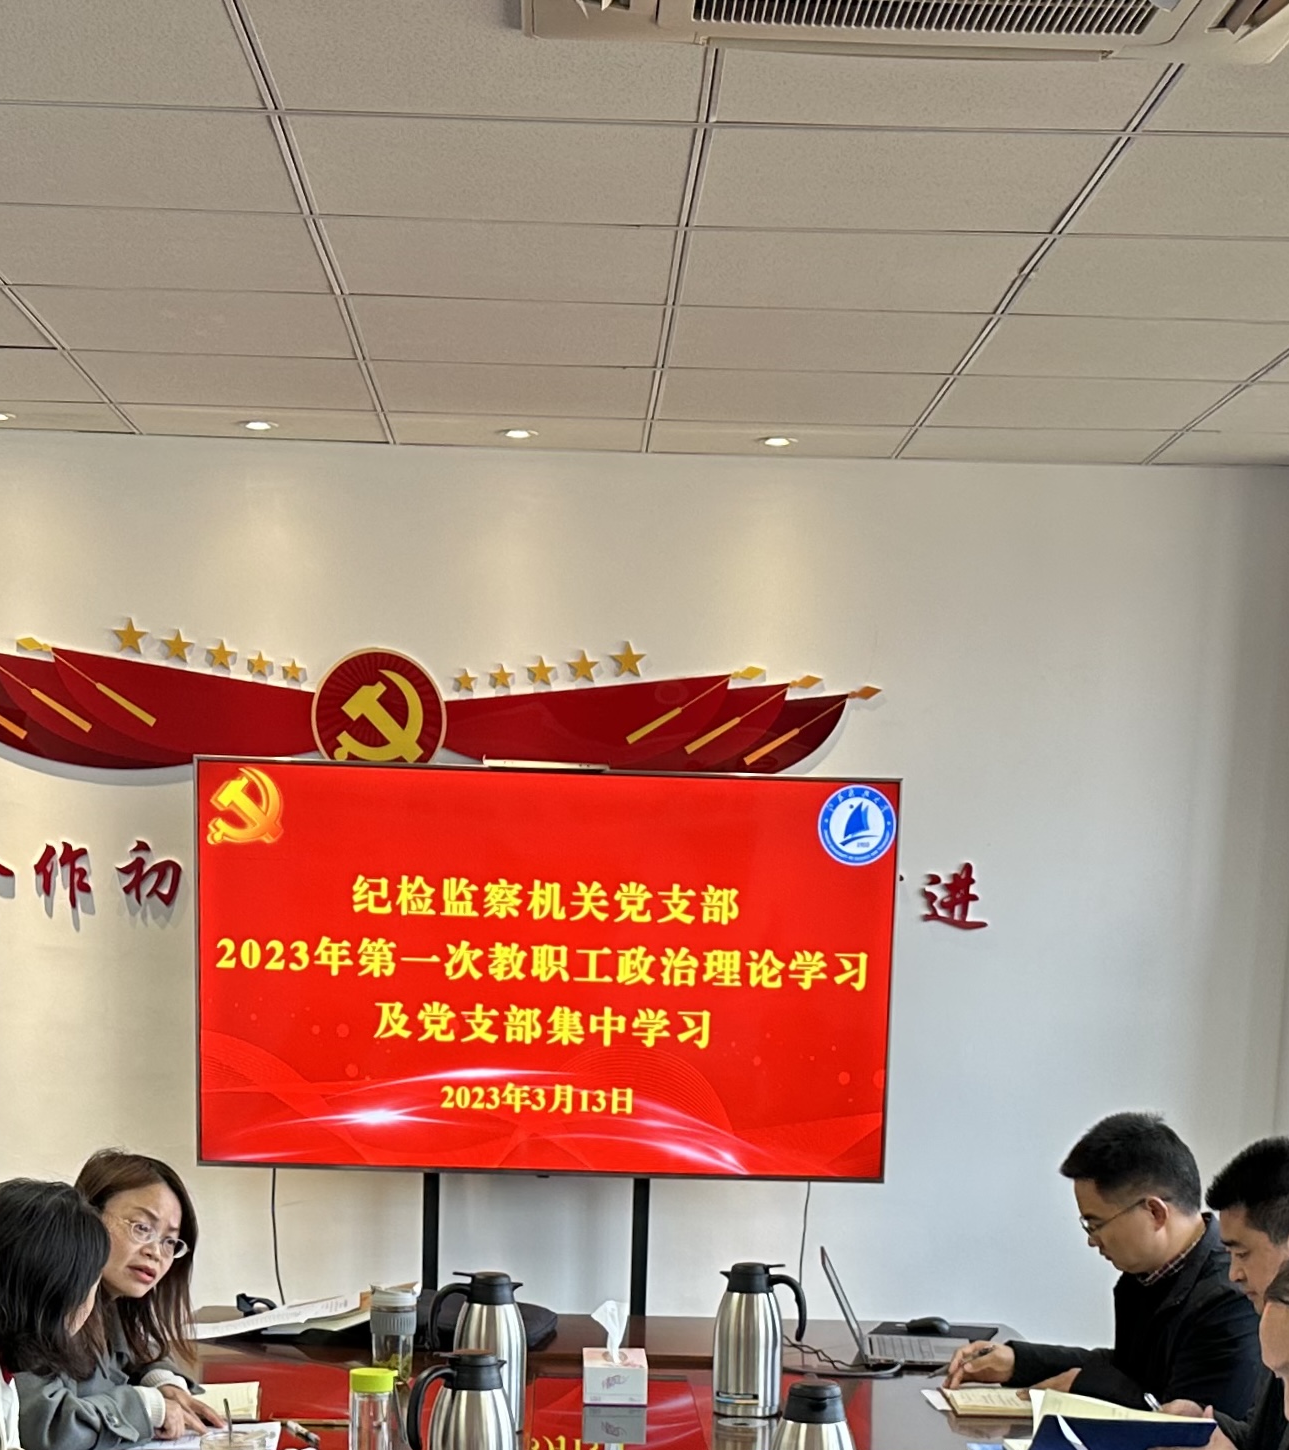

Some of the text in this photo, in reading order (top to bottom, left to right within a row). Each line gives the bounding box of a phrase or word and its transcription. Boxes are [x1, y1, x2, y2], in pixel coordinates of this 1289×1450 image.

[352, 873, 740, 925] 纪检监察机关党支部
[214, 935, 870, 993] 2023年第一次教职工政治理论学习
[372, 1000, 713, 1050] 及党支部集中学习
[439, 1082, 634, 1116] 2023年3月13日
